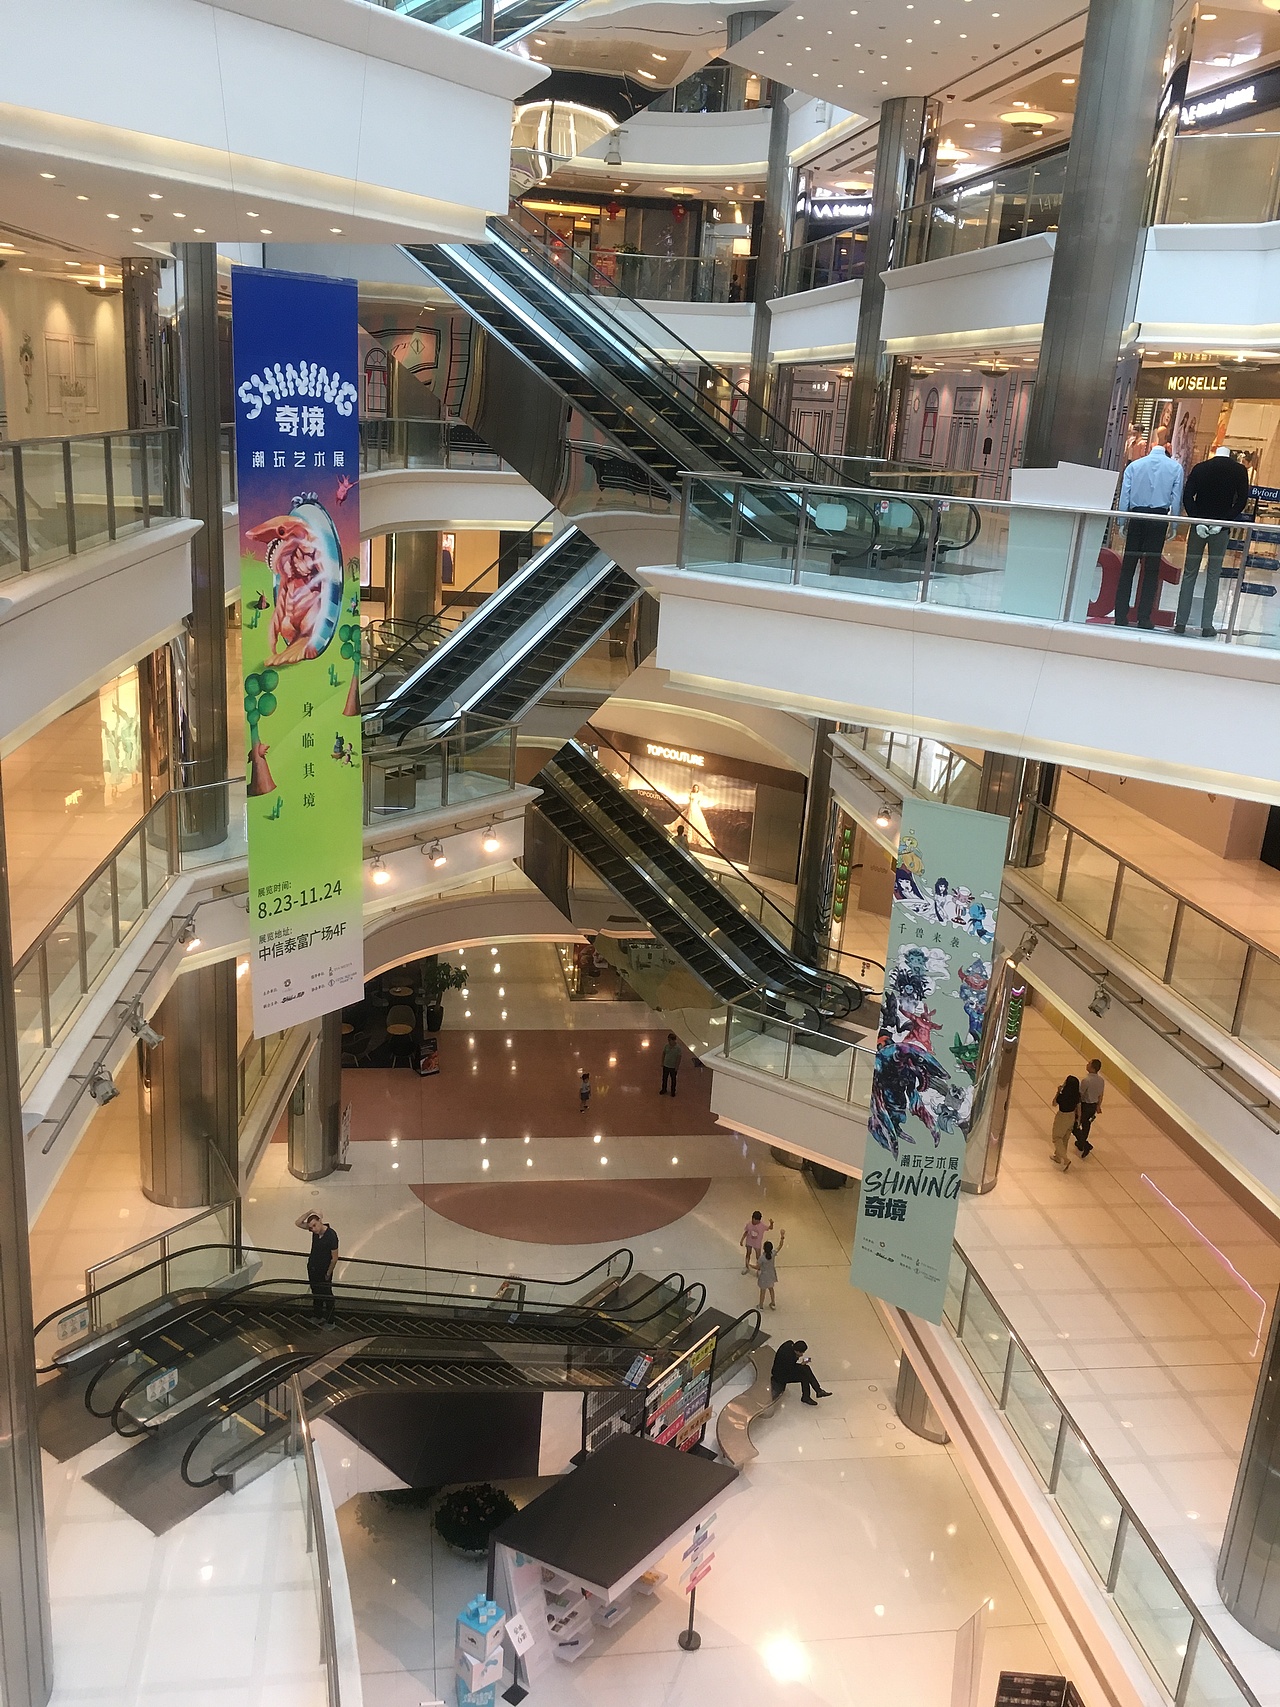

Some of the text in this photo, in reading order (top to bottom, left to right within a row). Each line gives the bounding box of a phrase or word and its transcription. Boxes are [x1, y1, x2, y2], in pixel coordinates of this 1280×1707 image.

[238, 360, 358, 420] SHINING
[1168, 376, 1228, 391] MOISELLE
[275, 405, 325, 437] 奇境
[252, 450, 345, 468] 潮玩艺术展
[1251, 488, 1279, 499] Byford
[302, 701, 316, 809] 身临其境
[646, 743, 705, 767] TOPCOUTURE
[258, 880, 342, 919] 8.23-11.24
[258, 921, 347, 962] 中信泰富广场4F
[900, 1154, 959, 1170] 潮玩艺术展
[863, 1167, 962, 1200] SHINING
[864, 1196, 907, 1222] 奇境
